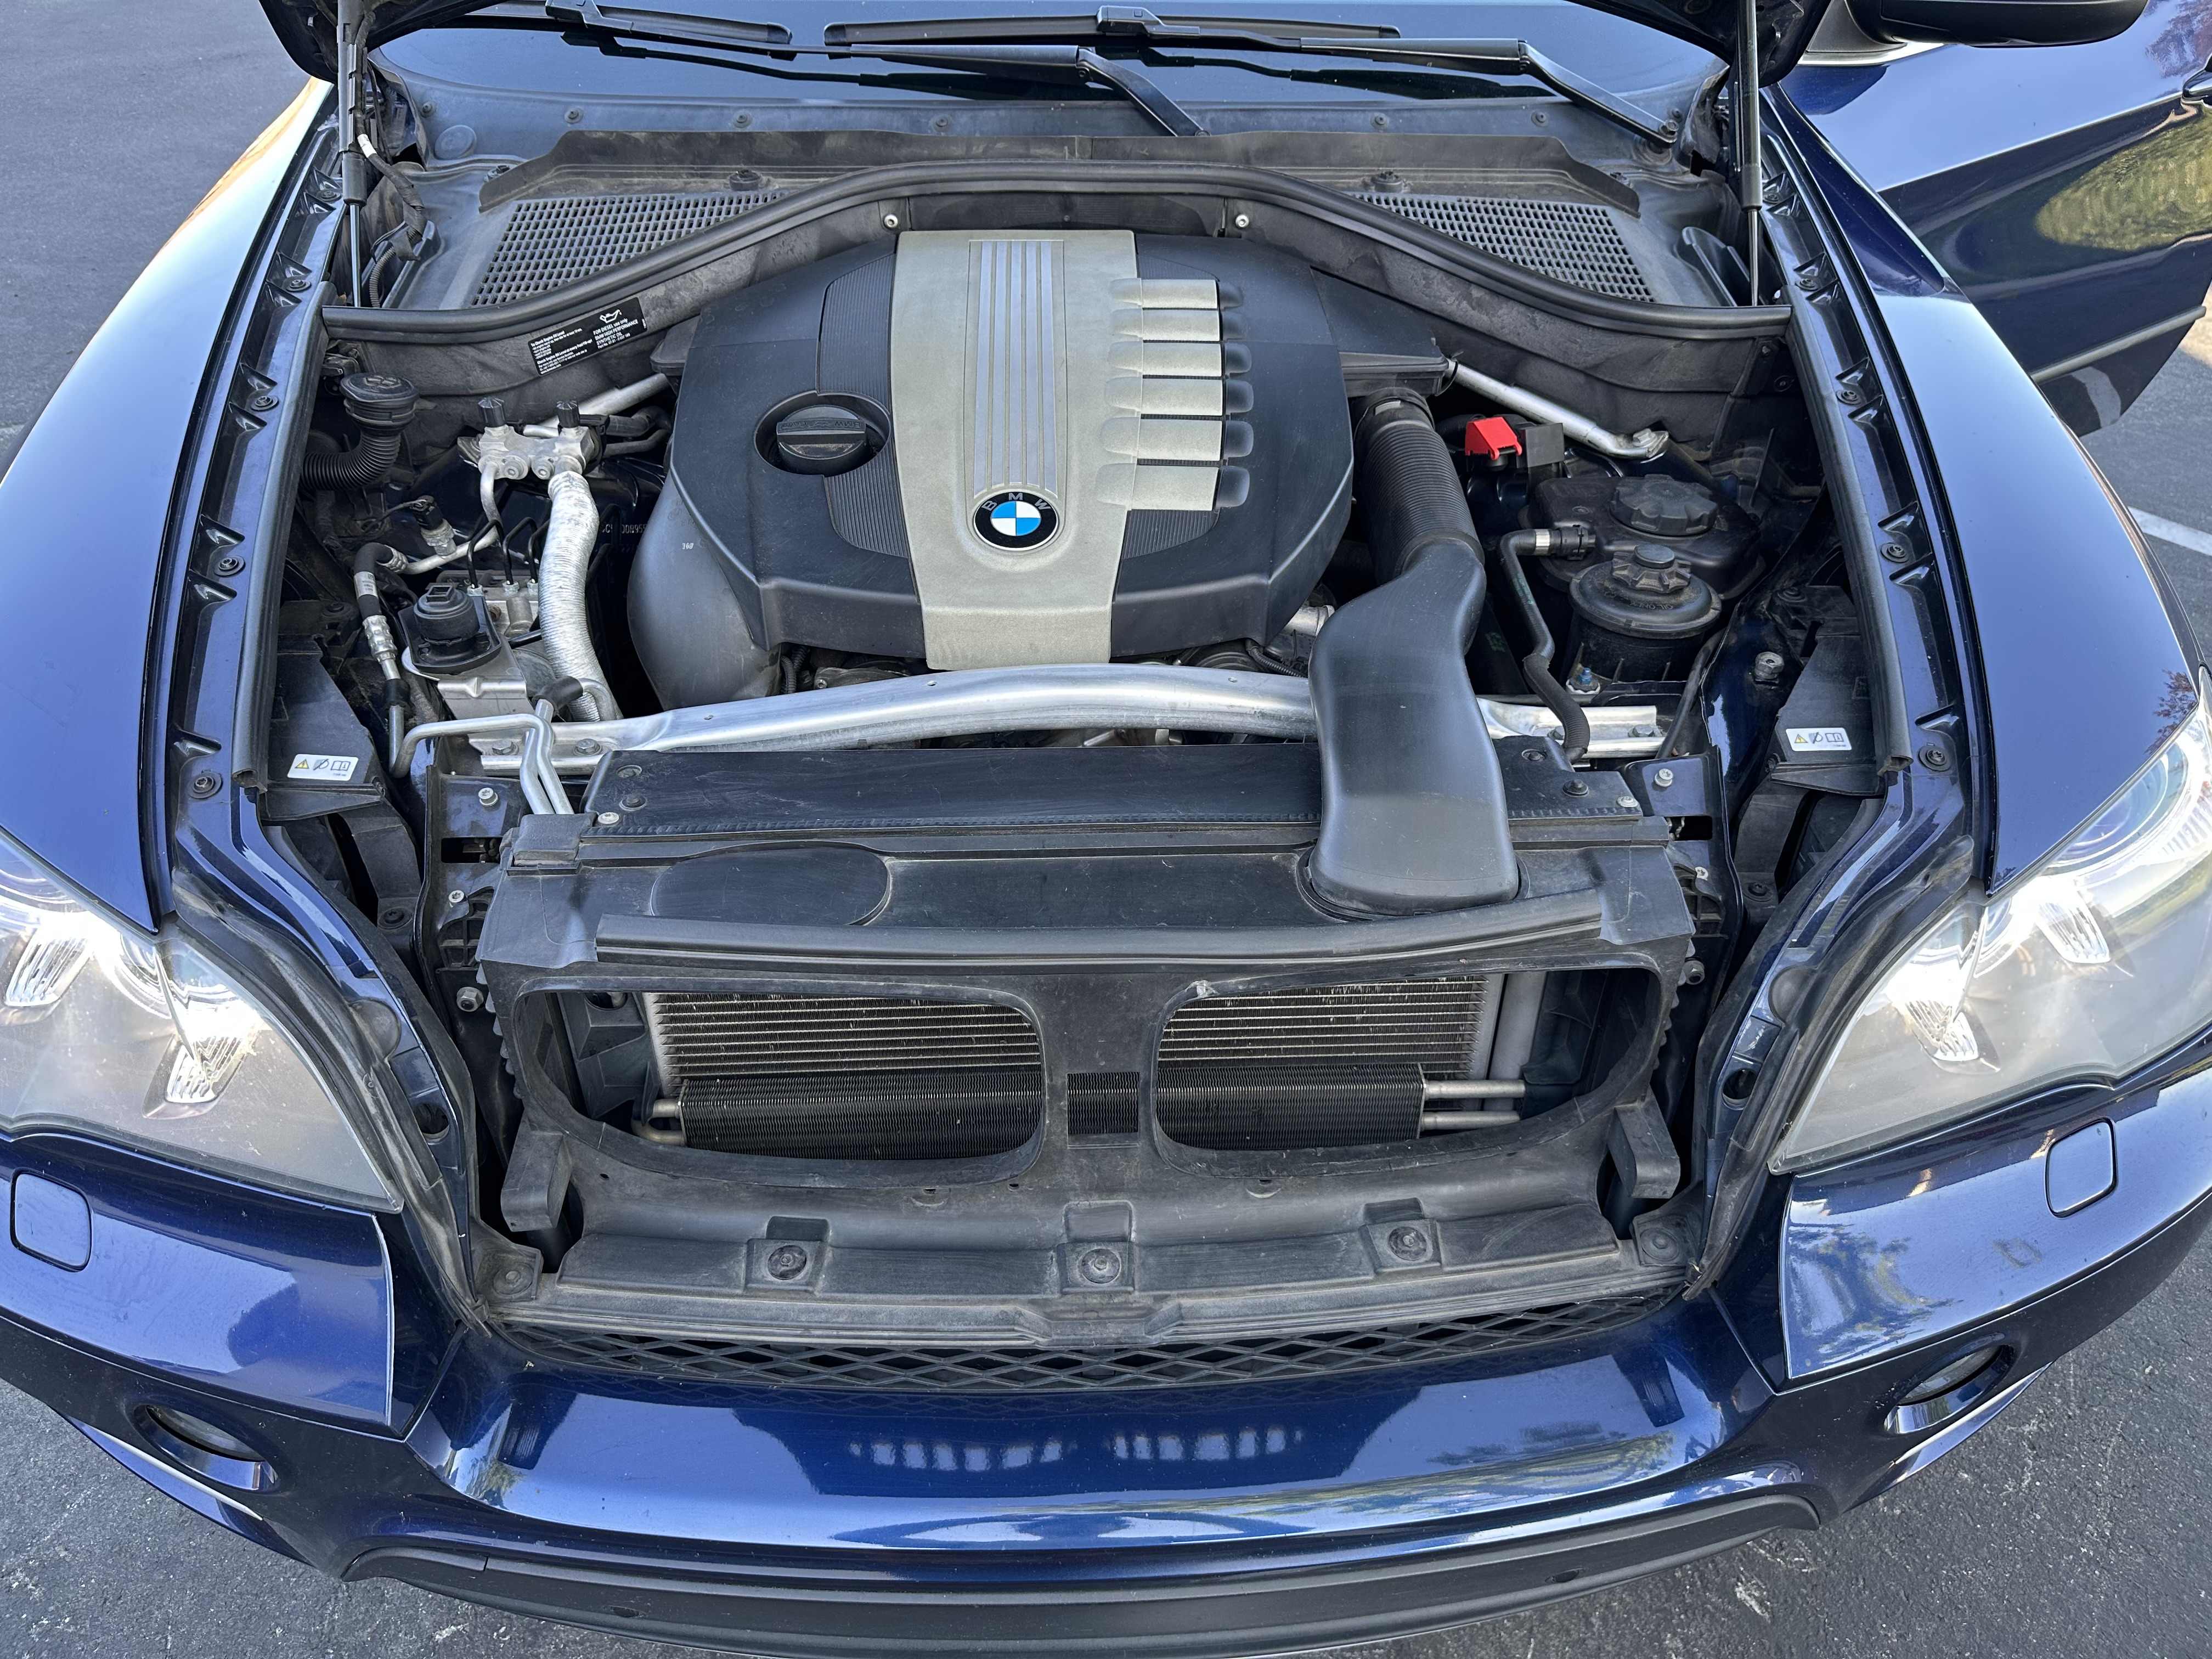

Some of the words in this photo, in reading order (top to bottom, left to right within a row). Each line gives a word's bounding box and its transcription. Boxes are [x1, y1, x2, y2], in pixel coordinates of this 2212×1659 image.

[613, 319, 638, 332] PERFORMANCE
[596, 334, 616, 345] SYNTHETIC
[981, 493, 1052, 511] BMW
